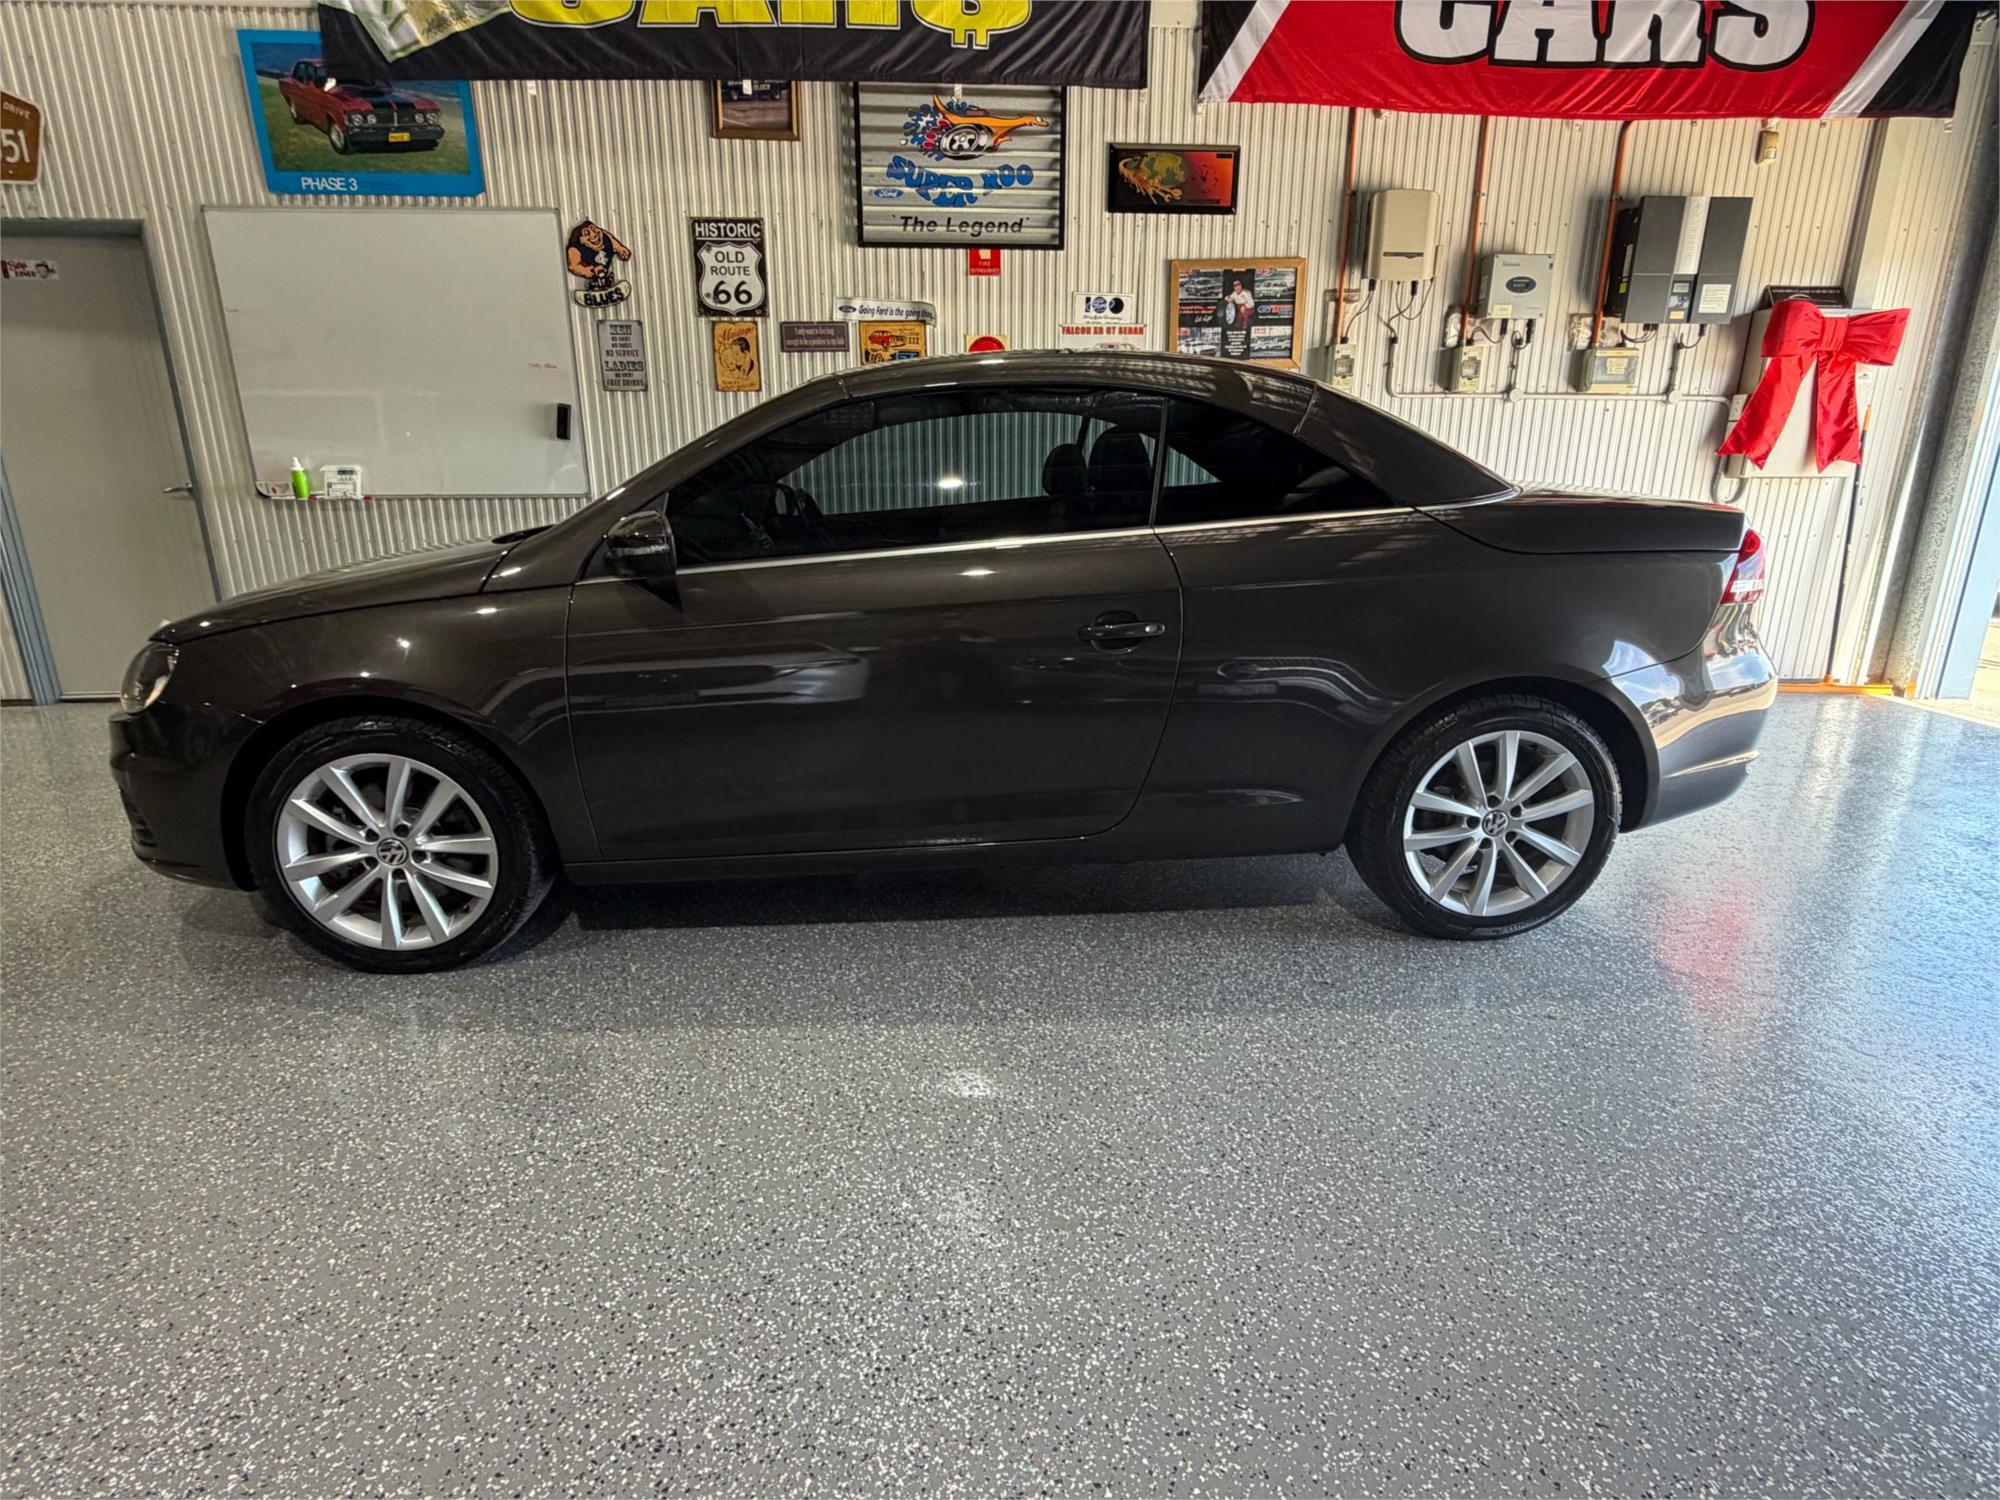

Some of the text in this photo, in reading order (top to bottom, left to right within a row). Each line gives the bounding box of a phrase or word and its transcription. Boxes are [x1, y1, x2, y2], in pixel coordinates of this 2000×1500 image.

[2, 101, 32, 120] DRIVE
[0, 128, 31, 164] 51
[301, 177, 358, 191] PHASE 3
[886, 155, 978, 208] SUPER
[694, 222, 761, 237] HISTORIC
[714, 251, 745, 263] OLD
[710, 265, 751, 276] ROUTE
[584, 287, 624, 306] BLUES
[713, 280, 753, 305] 66
[859, 304, 875, 318] Going
[876, 305, 889, 316] Ford
[895, 306, 904, 316] the
[904, 307, 920, 320] going
[1062, 326, 1091, 335] FALCON
[1118, 326, 1144, 335] SEDAN
